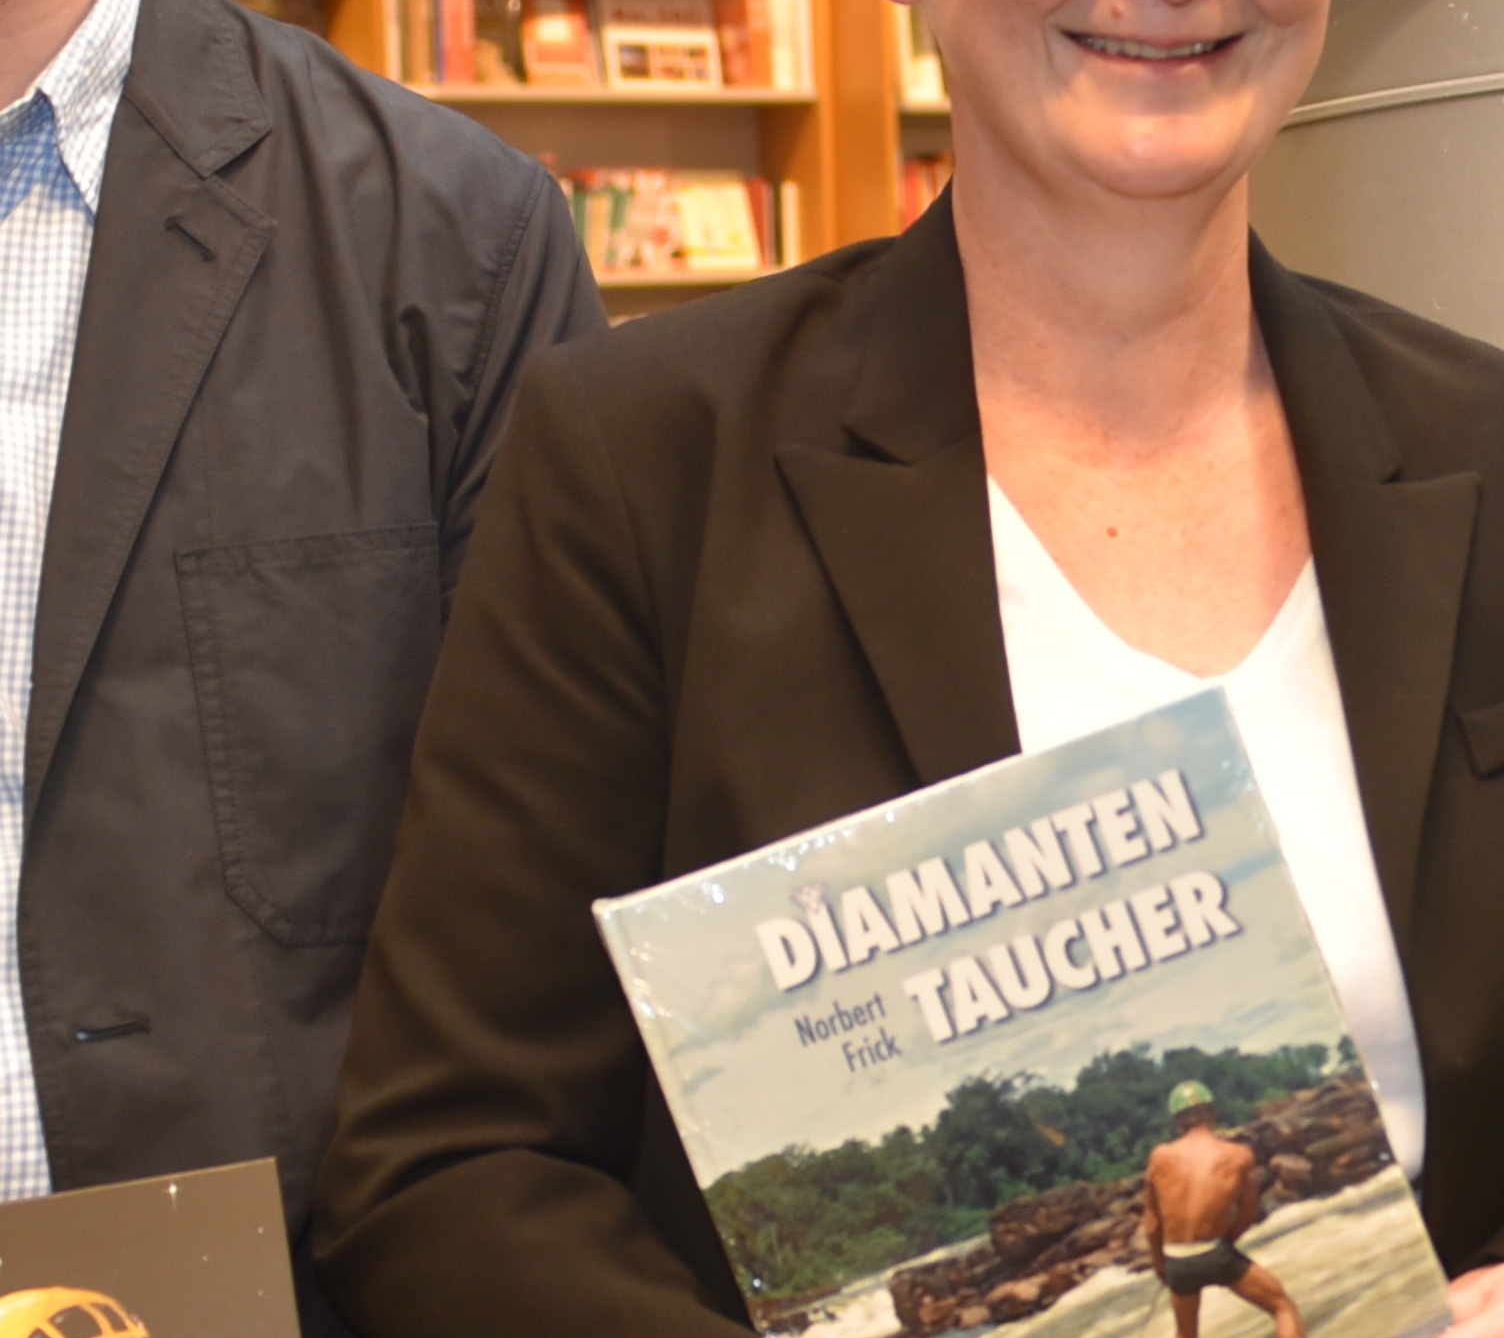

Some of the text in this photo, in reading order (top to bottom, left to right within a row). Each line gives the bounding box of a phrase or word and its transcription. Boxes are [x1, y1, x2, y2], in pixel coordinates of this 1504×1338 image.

[755, 768, 1205, 992] DIAMANTEN
[902, 870, 1243, 1044] TAUCHER
[794, 992, 887, 1047] Norbert
[841, 1028, 901, 1073] Frick
